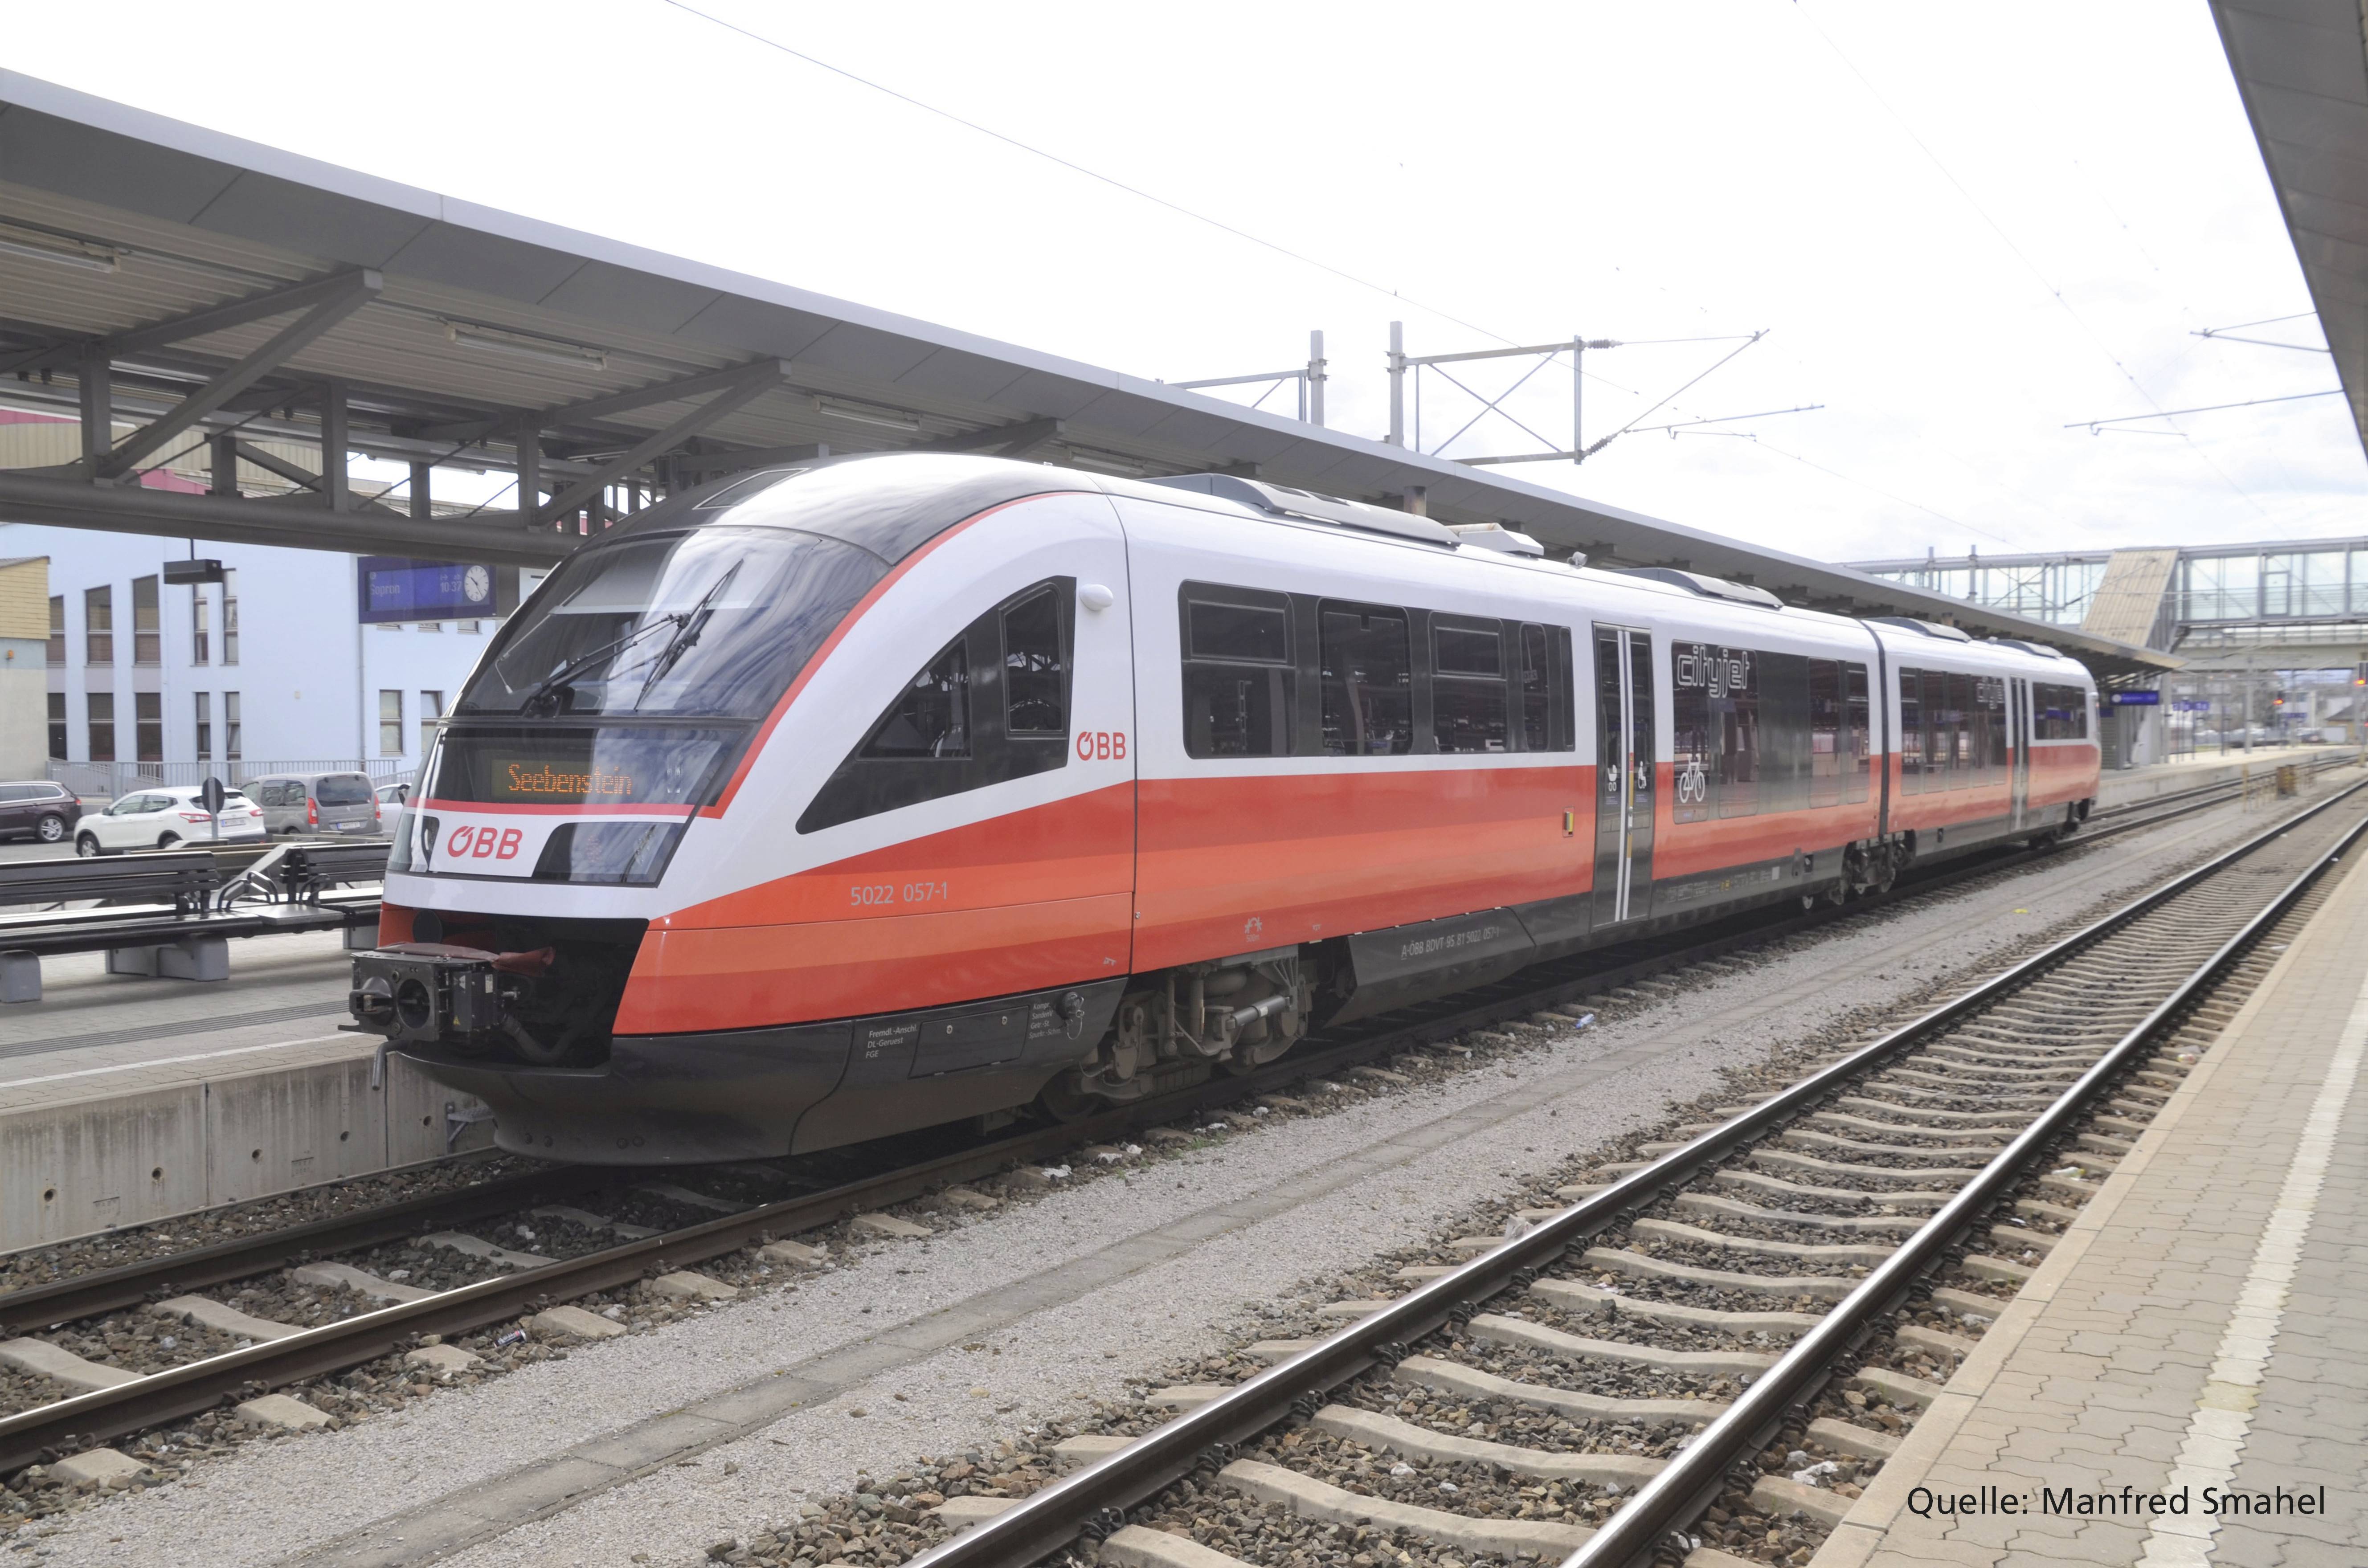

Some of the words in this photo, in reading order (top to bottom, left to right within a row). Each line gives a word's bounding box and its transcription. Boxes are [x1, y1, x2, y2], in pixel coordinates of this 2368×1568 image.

[370, 584, 400, 597] Sopron
[1677, 645, 1750, 698] cityjet
[1076, 731, 1126, 761] ÖBB
[508, 764, 632, 794] Seebenstein
[447, 825, 523, 860] ÖBB
[851, 885, 894, 906] 5022
[903, 881, 948, 902] 057-1
[1426, 937, 1444, 952] BDVT
[1446, 935, 1455, 948] 95
[1457, 932, 1465, 945] 81
[1466, 930, 1481, 944] 5022
[1483, 926, 1500, 940] 057-1
[866, 1050, 879, 1059] FGE
